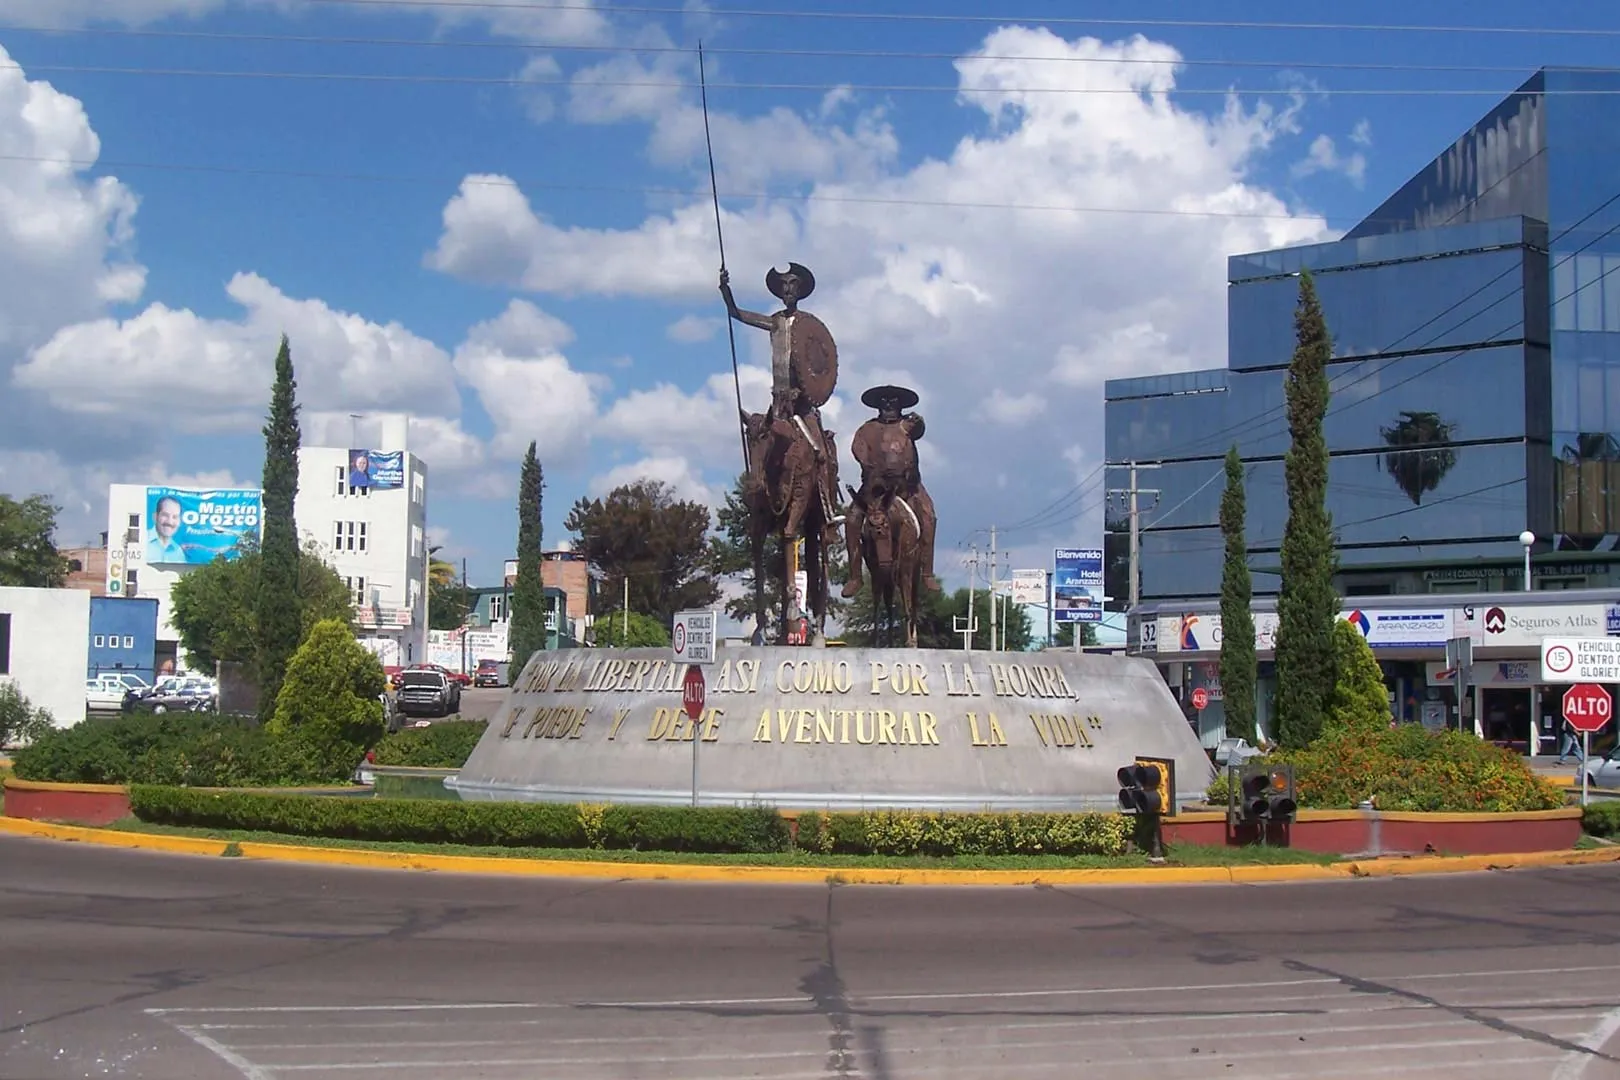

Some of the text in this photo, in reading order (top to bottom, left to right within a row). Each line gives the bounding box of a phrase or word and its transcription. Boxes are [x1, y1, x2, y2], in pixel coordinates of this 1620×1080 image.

[199, 501, 257, 514] Martín
[182, 510, 257, 526] Orozco
[1056, 550, 1102, 559] Bienvenido
[1081, 570, 1102, 578] Hotel
[1066, 610, 1094, 620] Ingreso
[1510, 616, 1560, 631] Seguros
[1564, 614, 1599, 628] Atlas
[1143, 623, 1156, 643] 32
[1553, 651, 1566, 661] 15
[1577, 654, 1614, 665] DENTRO
[712, 659, 762, 693] ASI
[776, 659, 854, 695] COMO
[869, 660, 930, 696] POR
[942, 661, 981, 697] LA
[988, 662, 1080, 703] HONRA,
[684, 681, 704, 703] ALTO
[1566, 696, 1608, 716] ALTO
[607, 705, 631, 741] Y
[752, 707, 940, 746] AVENTURAR
[966, 710, 1009, 747] LA
